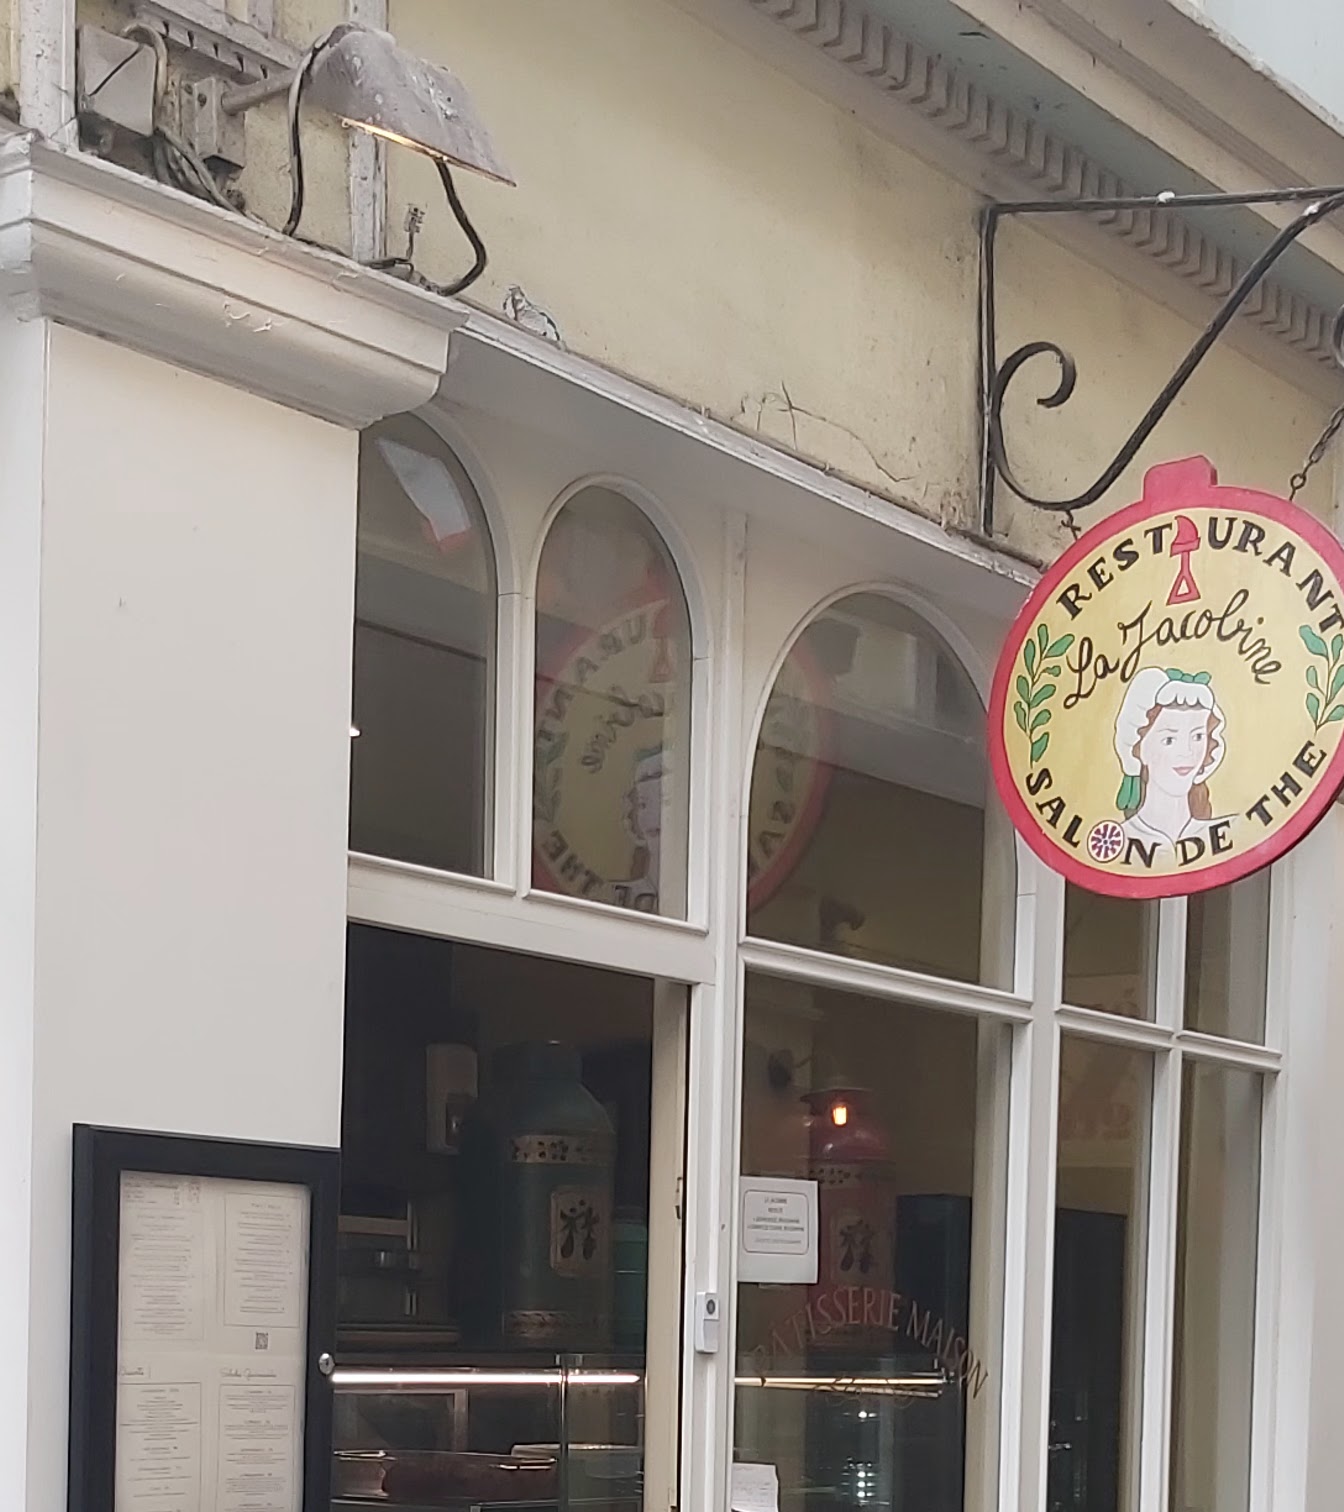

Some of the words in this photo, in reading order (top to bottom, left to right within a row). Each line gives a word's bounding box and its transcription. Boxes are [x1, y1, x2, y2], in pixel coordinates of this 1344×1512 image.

[1062, 637, 1120, 710] La
[1117, 588, 1282, 685] Jacobine
[1178, 820, 1235, 866] DE
[906, 1300, 989, 1398] MAISON
